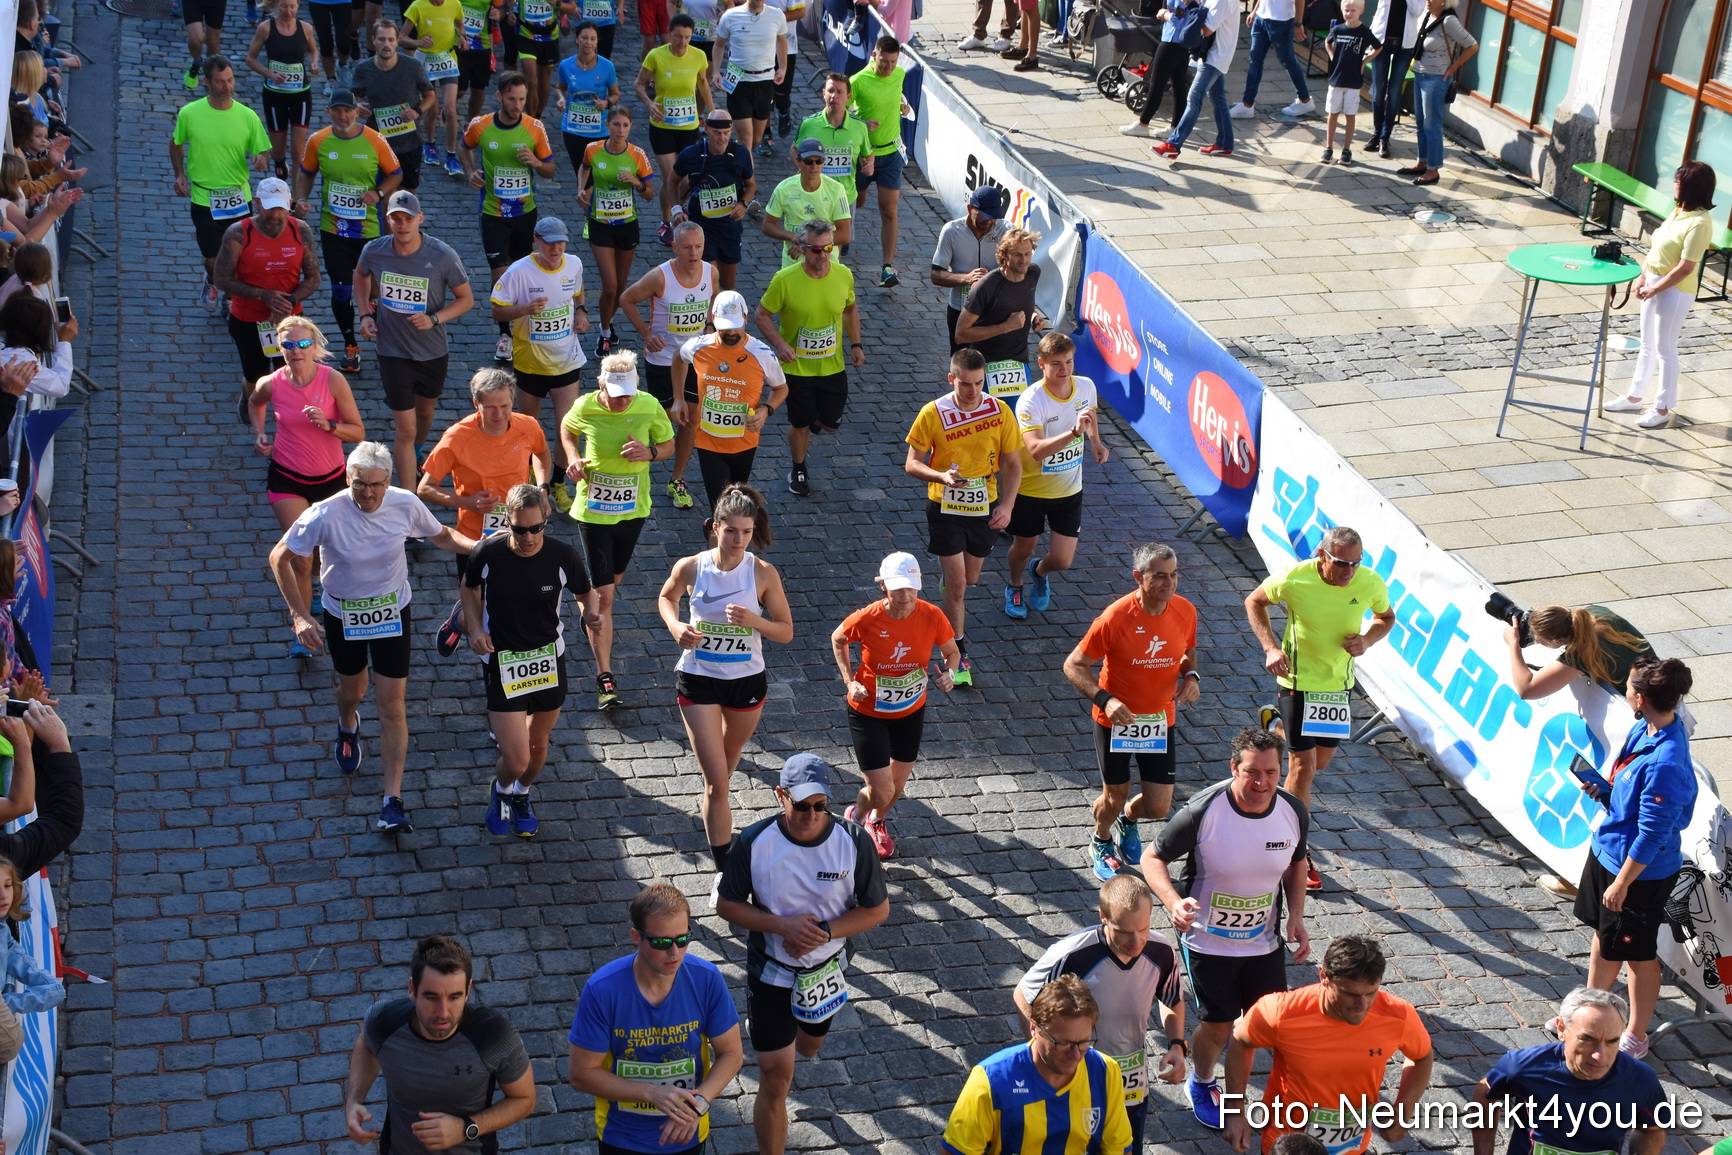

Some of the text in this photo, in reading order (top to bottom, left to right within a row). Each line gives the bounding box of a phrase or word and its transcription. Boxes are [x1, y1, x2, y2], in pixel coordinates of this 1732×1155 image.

[527, 5, 552, 13] 2714
[586, 9, 609, 17] 2009
[464, 17, 481, 28] 734
[694, 28, 706, 36] 48
[429, 61, 452, 72] 2207
[378, 107, 402, 117] BOC
[668, 107, 692, 117] 2211
[381, 116, 402, 128] 100
[571, 114, 598, 124] 2364
[388, 125, 409, 133] STEFAN
[824, 157, 849, 167] 212
[497, 169, 529, 177] BOCK
[332, 184, 366, 196] BOCK
[498, 178, 528, 189] 2513
[599, 190, 629, 198] BOCK
[702, 188, 734, 199] BOCK
[214, 195, 243, 209] 2765
[332, 195, 363, 208] 2509
[601, 200, 629, 210] 1284
[705, 195, 733, 210] 1389
[334, 207, 360, 216] MARKUS
[384, 276, 424, 289] BOCK
[385, 286, 422, 302] 2128
[391, 302, 414, 311] TIMON
[533, 307, 567, 319] BOCK
[671, 303, 706, 314] BOCK
[535, 318, 567, 333] 2337
[673, 313, 704, 326] 1200
[1085, 278, 1139, 360] Hervis
[535, 332, 568, 341] REINHARD
[802, 328, 836, 339] BOCK
[802, 339, 831, 350] 1226
[1146, 331, 1169, 355] STORE
[988, 361, 1019, 371] BOCK
[1153, 357, 1173, 385] ONLINE
[702, 373, 747, 386] SportScheck
[992, 371, 1021, 385] 1227
[1150, 383, 1171, 413] MOBILE
[705, 400, 743, 412] BOCK
[706, 411, 741, 426] 1360
[1193, 376, 1251, 474] Hervis
[946, 418, 1003, 442] MAX BÖGL
[1048, 447, 1080, 465] 2304
[1049, 461, 1079, 471] ANDREAS
[593, 474, 635, 487] BOCK
[593, 487, 633, 502] 2248
[949, 489, 984, 503] 1239
[599, 503, 624, 511] ERICH
[946, 504, 984, 512] MATTHIAS
[490, 516, 509, 529] 24
[345, 594, 397, 610] BOCK
[348, 608, 394, 626] 3002
[349, 623, 397, 636] BERNHARD
[700, 622, 749, 635] BOCK
[701, 636, 747, 652] 2774
[503, 645, 555, 664] BOCK
[1131, 657, 1174, 666] funrunners
[506, 659, 551, 680] 1088
[511, 677, 549, 691] CARSTEN
[881, 671, 922, 686] BOCK
[883, 683, 922, 702] 2763
[1308, 692, 1348, 704] BOCK
[1308, 705, 1348, 722] 2800
[1118, 723, 1160, 738] 2301
[1265, 841, 1285, 849] swn
[817, 871, 840, 879] swn
[1218, 894, 1269, 910] BOCK
[1215, 910, 1265, 928] 2222
[1228, 931, 1251, 939] UWE
[796, 975, 839, 1008] 2525
[614, 1020, 700, 1039] 10. NEUMARKTER
[627, 1034, 689, 1048] STADTLAUF
[624, 1061, 689, 1077] BOCK
[1314, 1126, 1362, 1144] 2700
